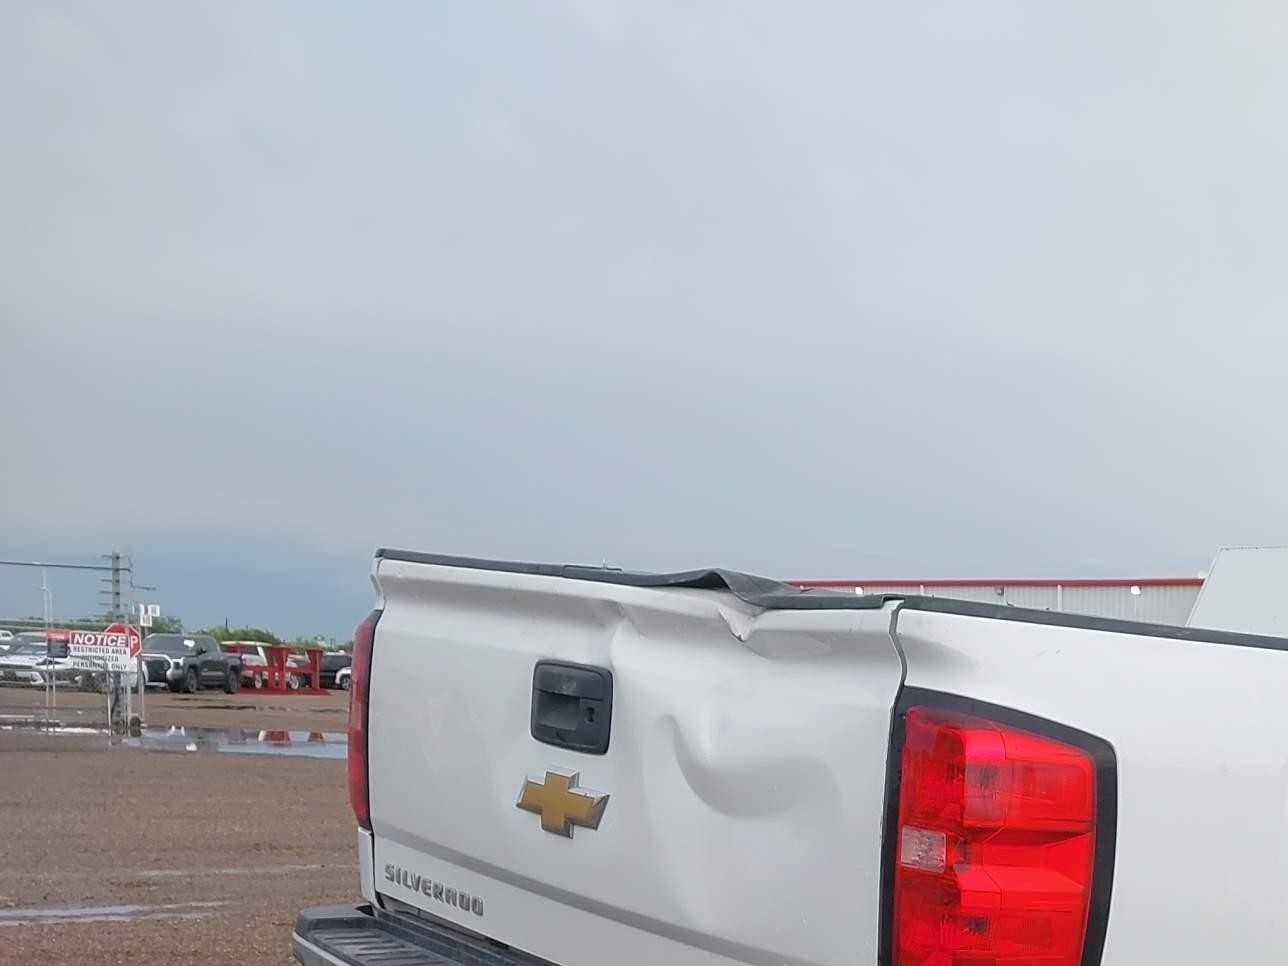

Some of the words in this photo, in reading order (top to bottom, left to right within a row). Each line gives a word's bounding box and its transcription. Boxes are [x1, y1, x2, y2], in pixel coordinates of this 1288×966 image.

[73, 633, 127, 647] NOTICE
[73, 645, 110, 655] RESTRICTED
[111, 647, 127, 656] AREA
[111, 662, 127, 670] ONLY
[384, 863, 484, 917] SILVERADO
